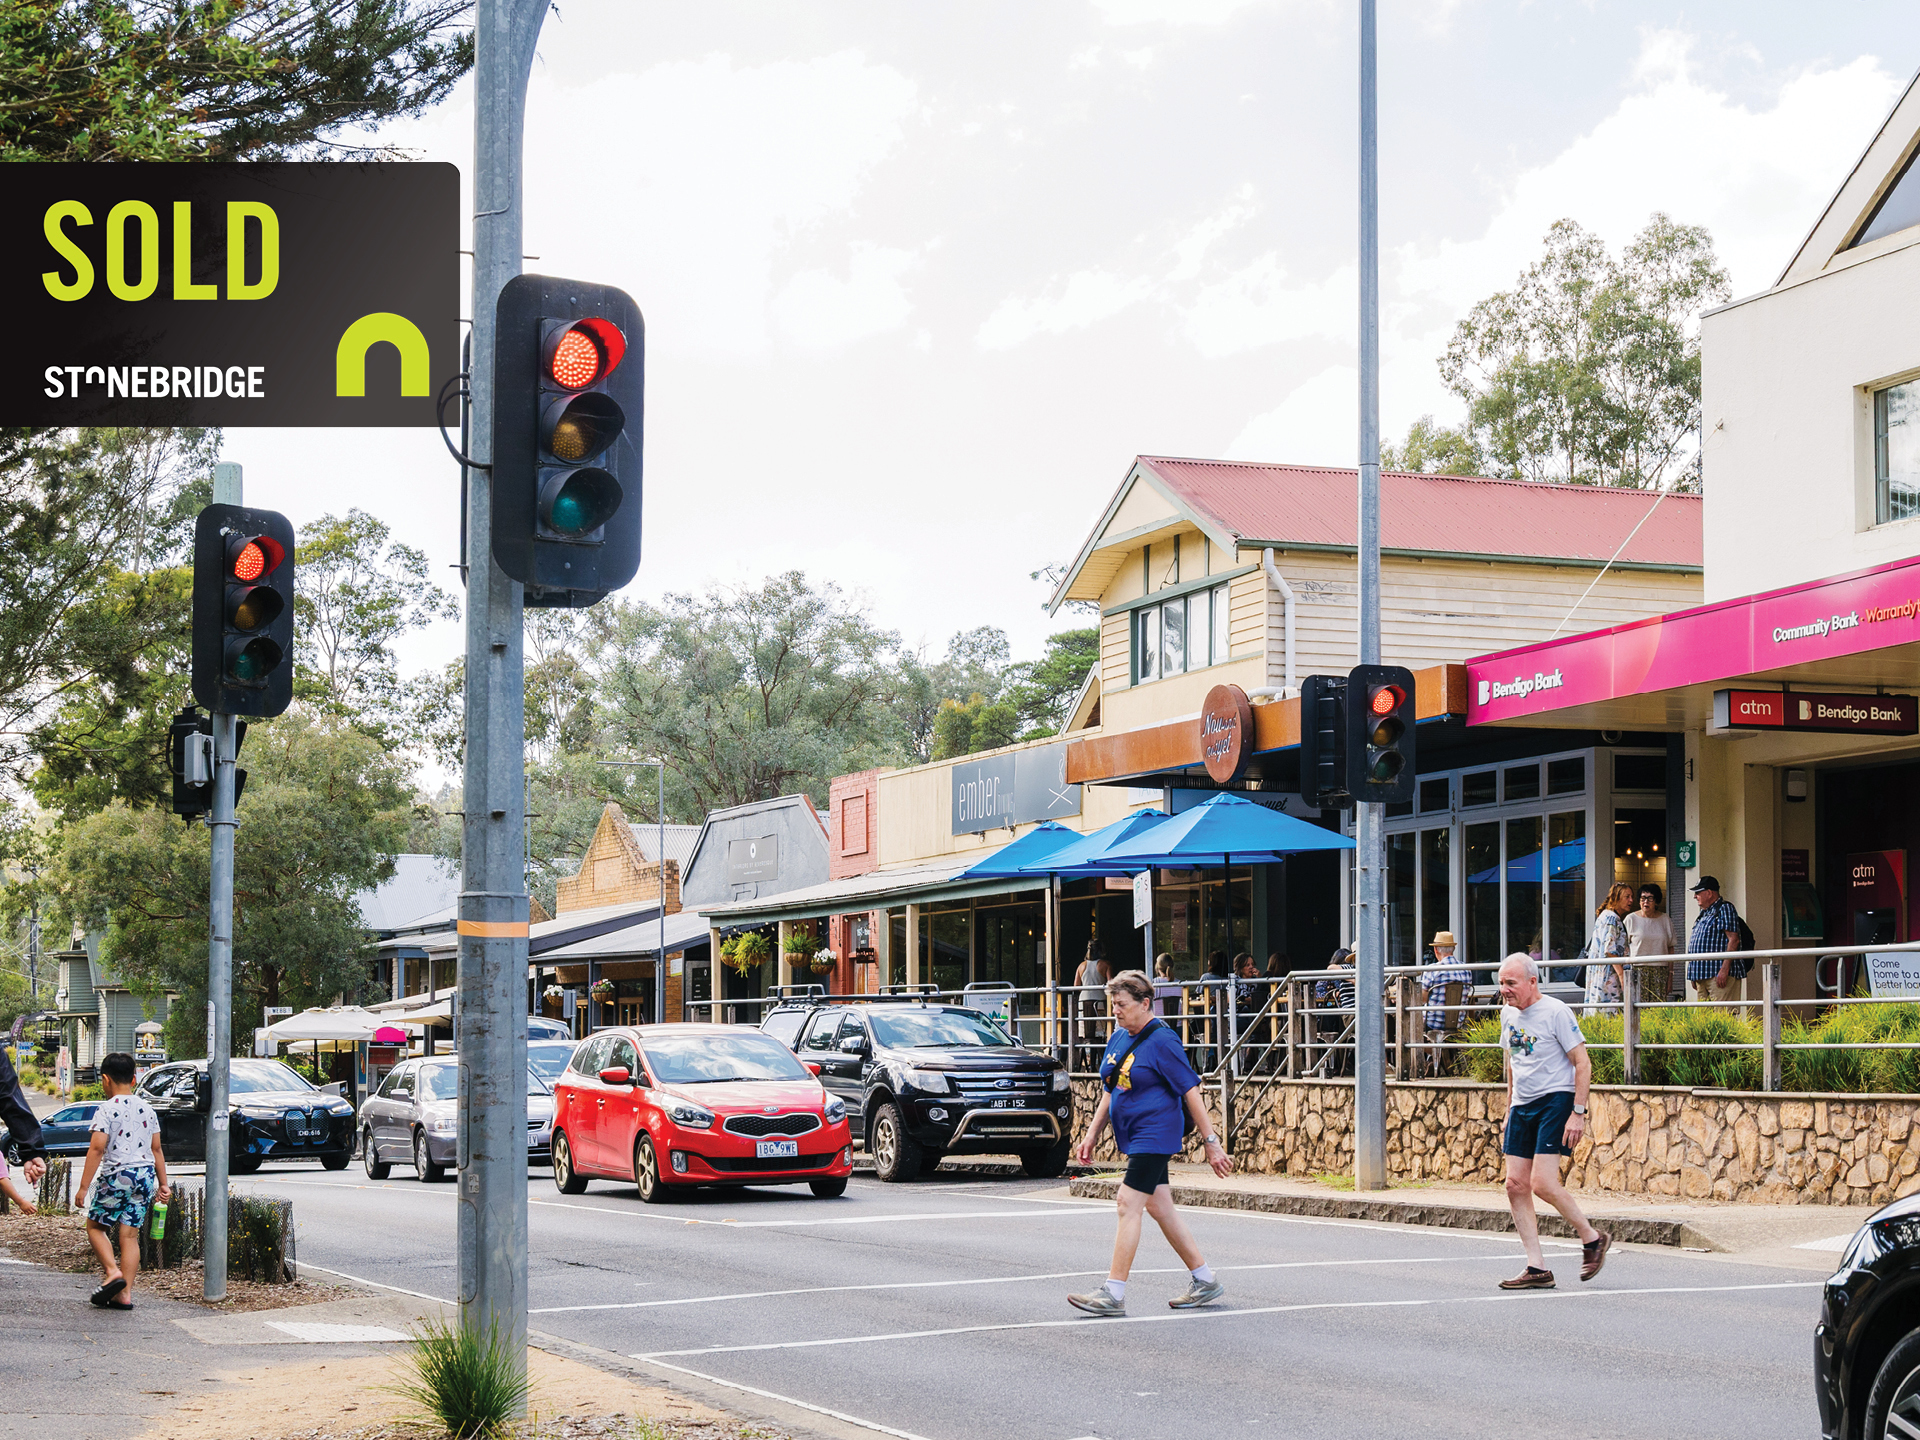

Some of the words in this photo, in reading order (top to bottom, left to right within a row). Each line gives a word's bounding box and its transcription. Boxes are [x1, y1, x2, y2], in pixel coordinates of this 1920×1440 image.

[1772, 618, 1830, 642] Community
[1831, 611, 1859, 631] Bank
[1492, 676, 1534, 698] Bendigo
[1535, 668, 1563, 691] Bank
[1740, 700, 1771, 716] atm
[1817, 704, 1867, 723] Bendigo
[1870, 705, 1901, 721] Bank
[959, 768, 1000, 821] ember
[1852, 864, 1875, 878] atm
[1872, 958, 1900, 968] Come
[1873, 969, 1899, 978] home
[1901, 970, 1911, 978] to
[1875, 979, 1902, 989] better
[1904, 979, 1920, 989] loa
[759, 1144, 774, 1154] 1BG
